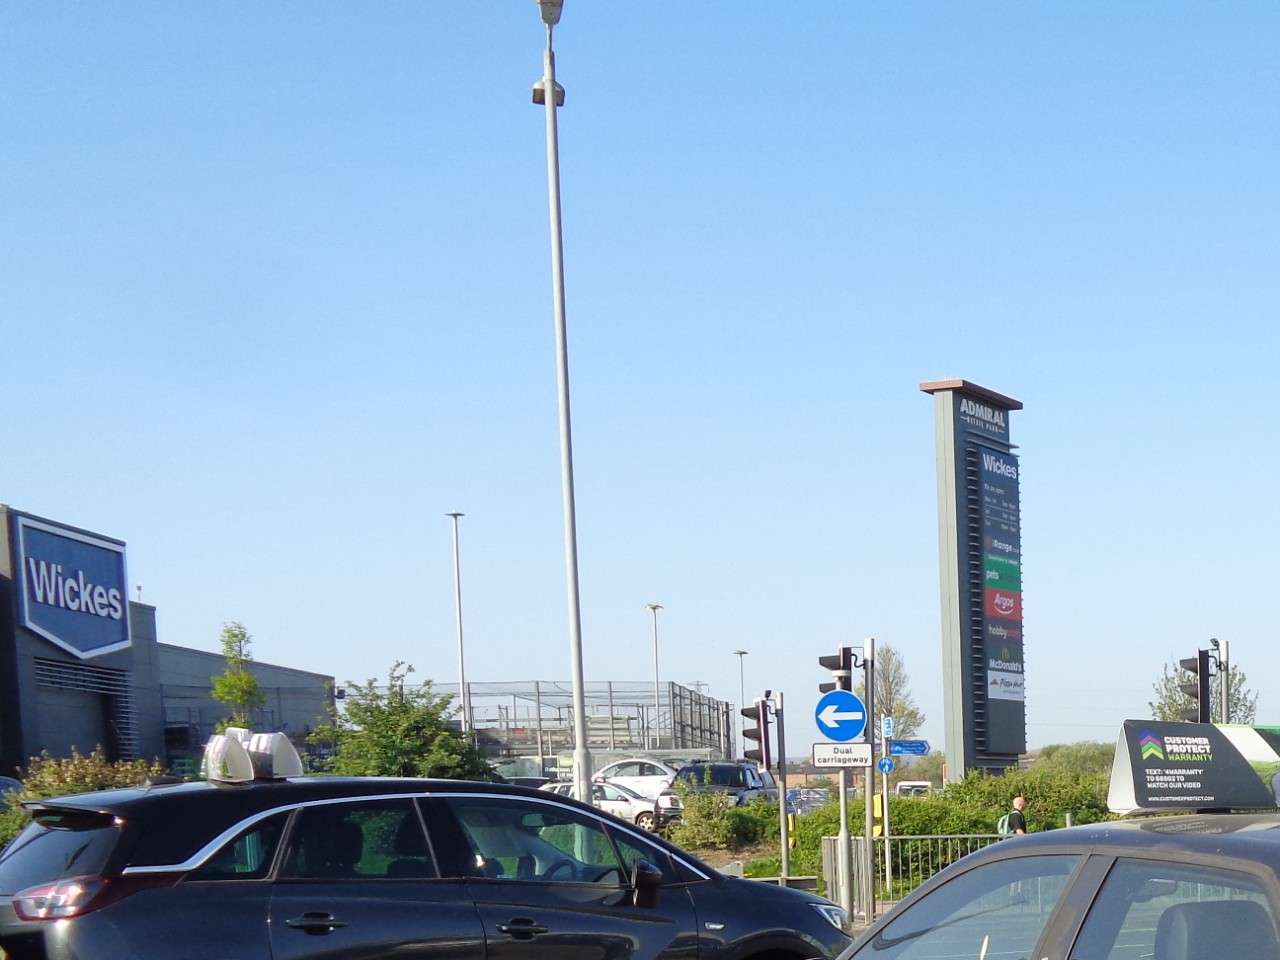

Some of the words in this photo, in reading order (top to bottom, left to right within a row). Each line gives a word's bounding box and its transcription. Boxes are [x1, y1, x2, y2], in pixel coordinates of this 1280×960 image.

[960, 398, 1006, 427] ADMIRAL
[982, 453, 1017, 479] Wickes
[28, 556, 122, 620] Wickes
[993, 593, 1015, 609] Argos
[1164, 736, 1209, 745] CUSTOMER
[833, 747, 853, 755] Dual
[1165, 744, 1211, 754] PROTECT
[817, 755, 869, 764] carriageway
[1167, 753, 1213, 761] WARRANTY
